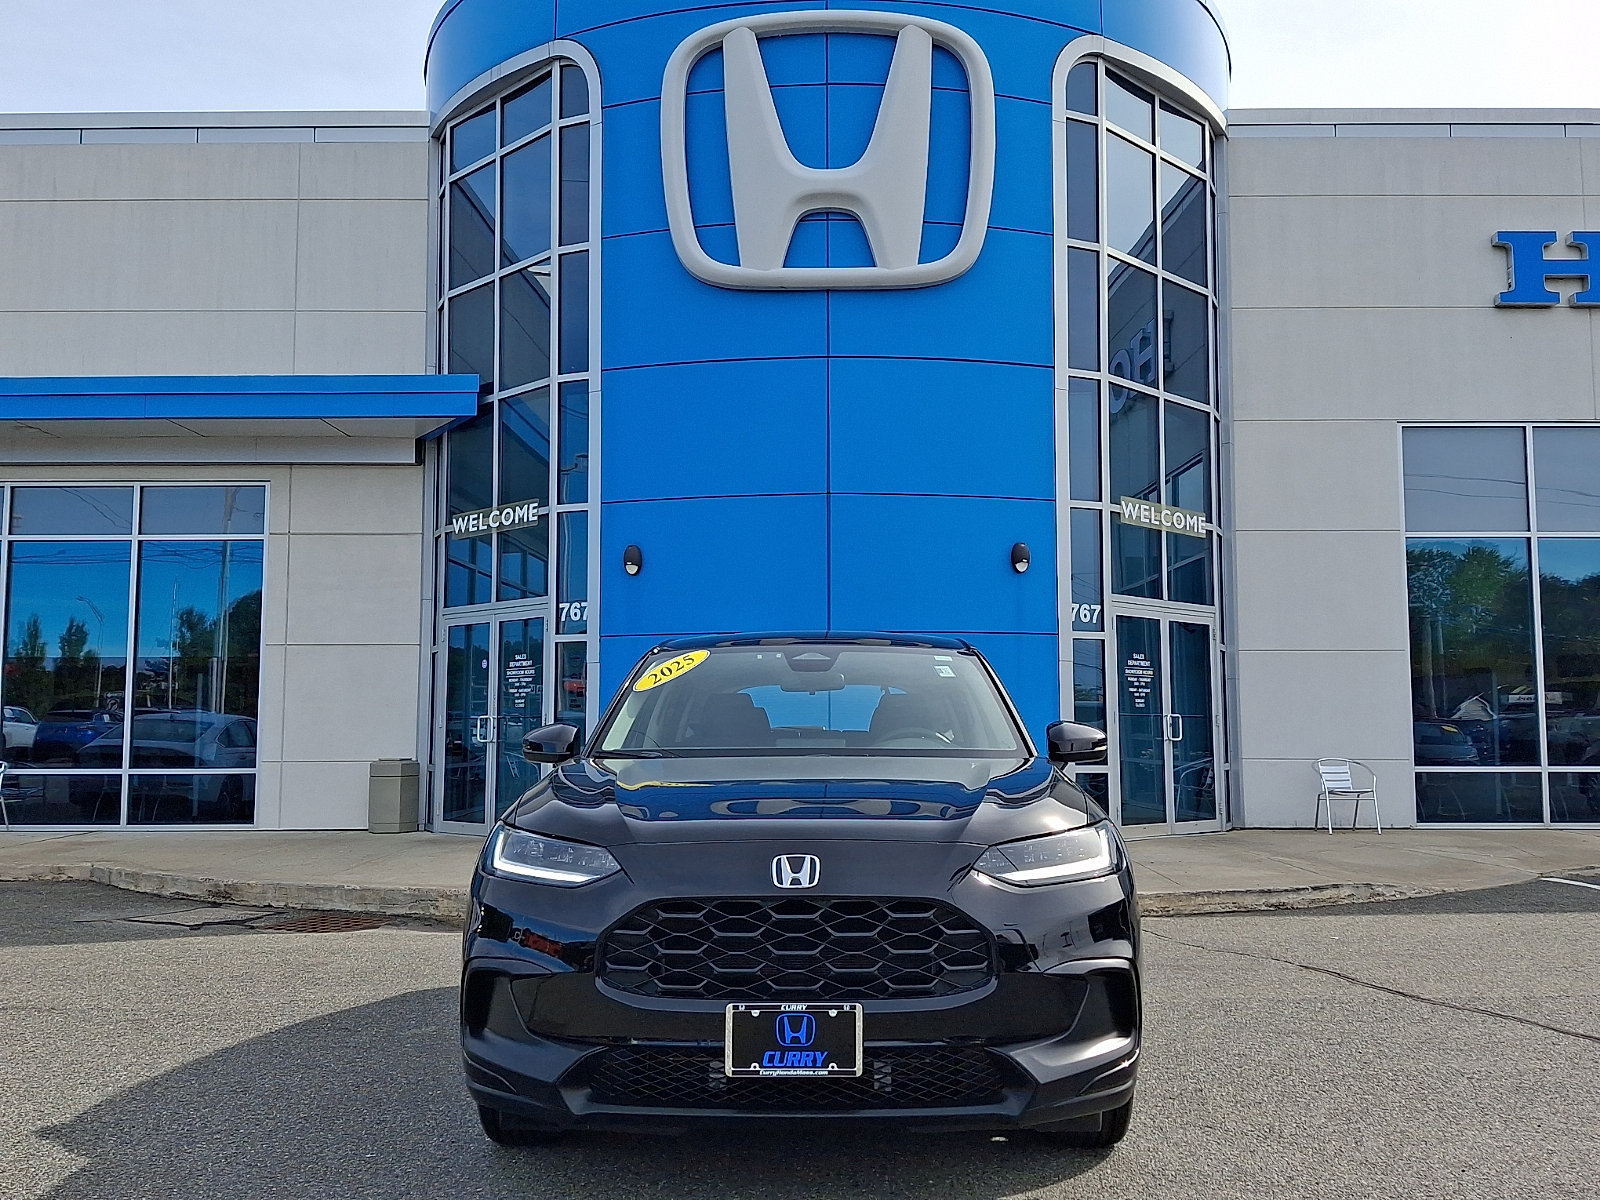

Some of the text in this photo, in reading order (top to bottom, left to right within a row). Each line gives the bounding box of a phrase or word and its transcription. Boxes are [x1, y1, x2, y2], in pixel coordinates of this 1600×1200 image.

[453, 502, 539, 534] WELCOME
[1120, 500, 1206, 534] WELCOME
[559, 602, 588, 621] 767
[1071, 603, 1101, 623] 767
[648, 655, 694, 685] 2025
[762, 1051, 829, 1067] CURRY
